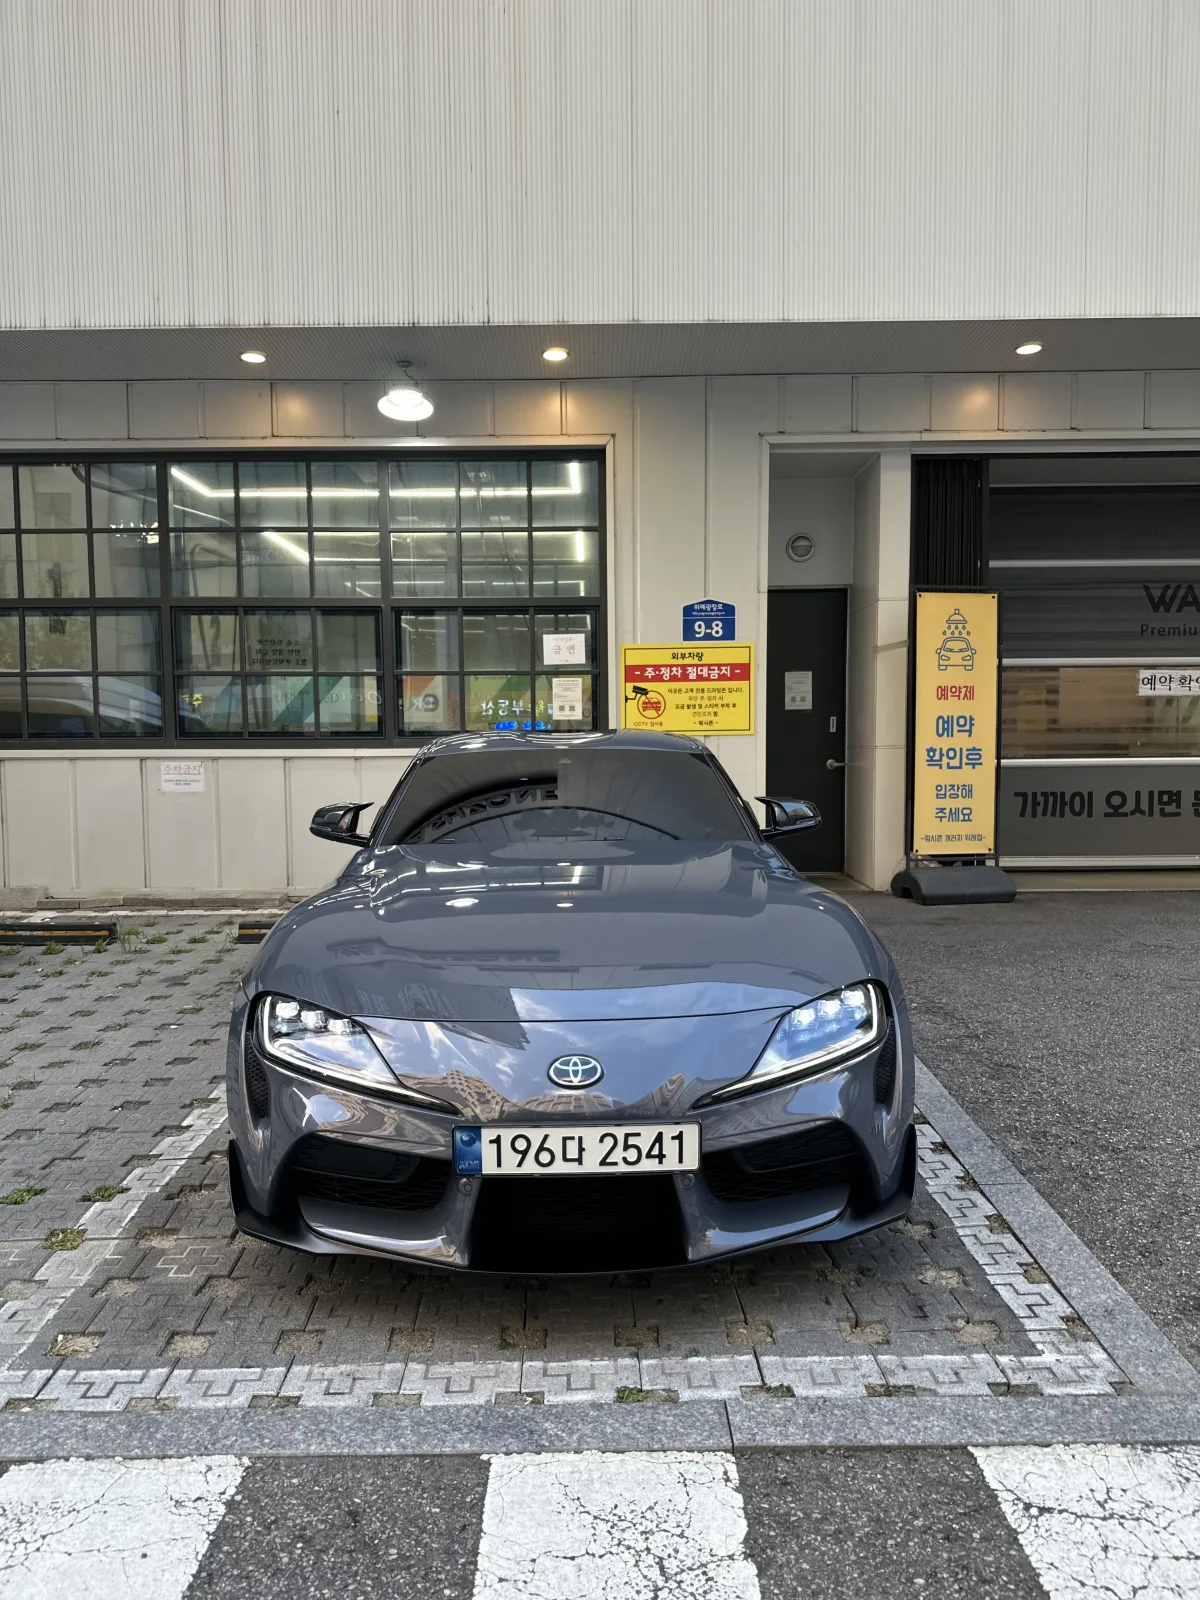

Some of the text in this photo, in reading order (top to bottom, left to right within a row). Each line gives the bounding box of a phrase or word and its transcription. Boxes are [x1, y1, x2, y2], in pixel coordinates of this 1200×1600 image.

[694, 620, 723, 638] 9-8
[1140, 623, 1197, 636] Premiu
[671, 652, 704, 661] 외부차량
[644, 665, 731, 680] 주·정차 절대금지
[1142, 674, 1174, 692] 예약
[936, 685, 974, 700] 예약제
[935, 715, 974, 738] 예약
[926, 746, 983, 770] 확인후
[164, 764, 201, 775] 주차금지
[935, 784, 973, 800] 입장해
[1014, 791, 1094, 818] 가까이
[1103, 790, 1182, 818] 오시면
[935, 807, 973, 823] 주세요
[488, 1130, 684, 1168] 196다 2541
